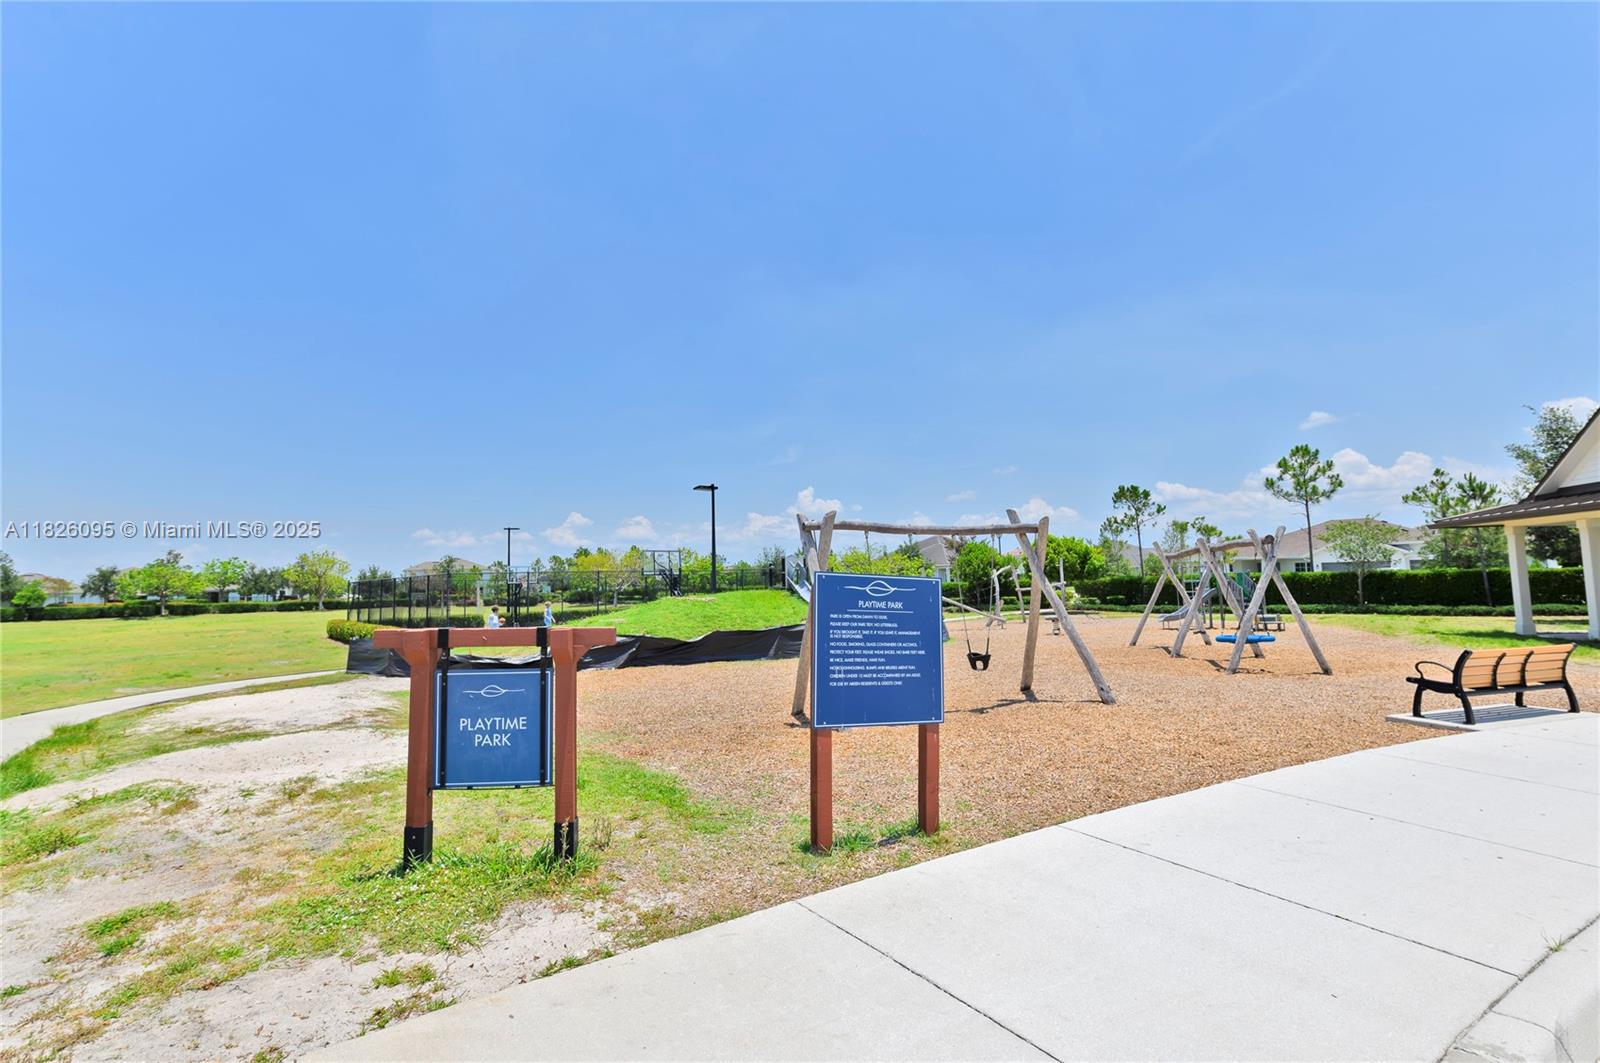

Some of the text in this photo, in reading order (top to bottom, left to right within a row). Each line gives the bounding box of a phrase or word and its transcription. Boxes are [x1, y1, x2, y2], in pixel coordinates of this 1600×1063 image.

[858, 600, 904, 609] PLAYTIME PARK
[459, 717, 527, 731] PLAYTIME
[474, 733, 512, 747] PARK
